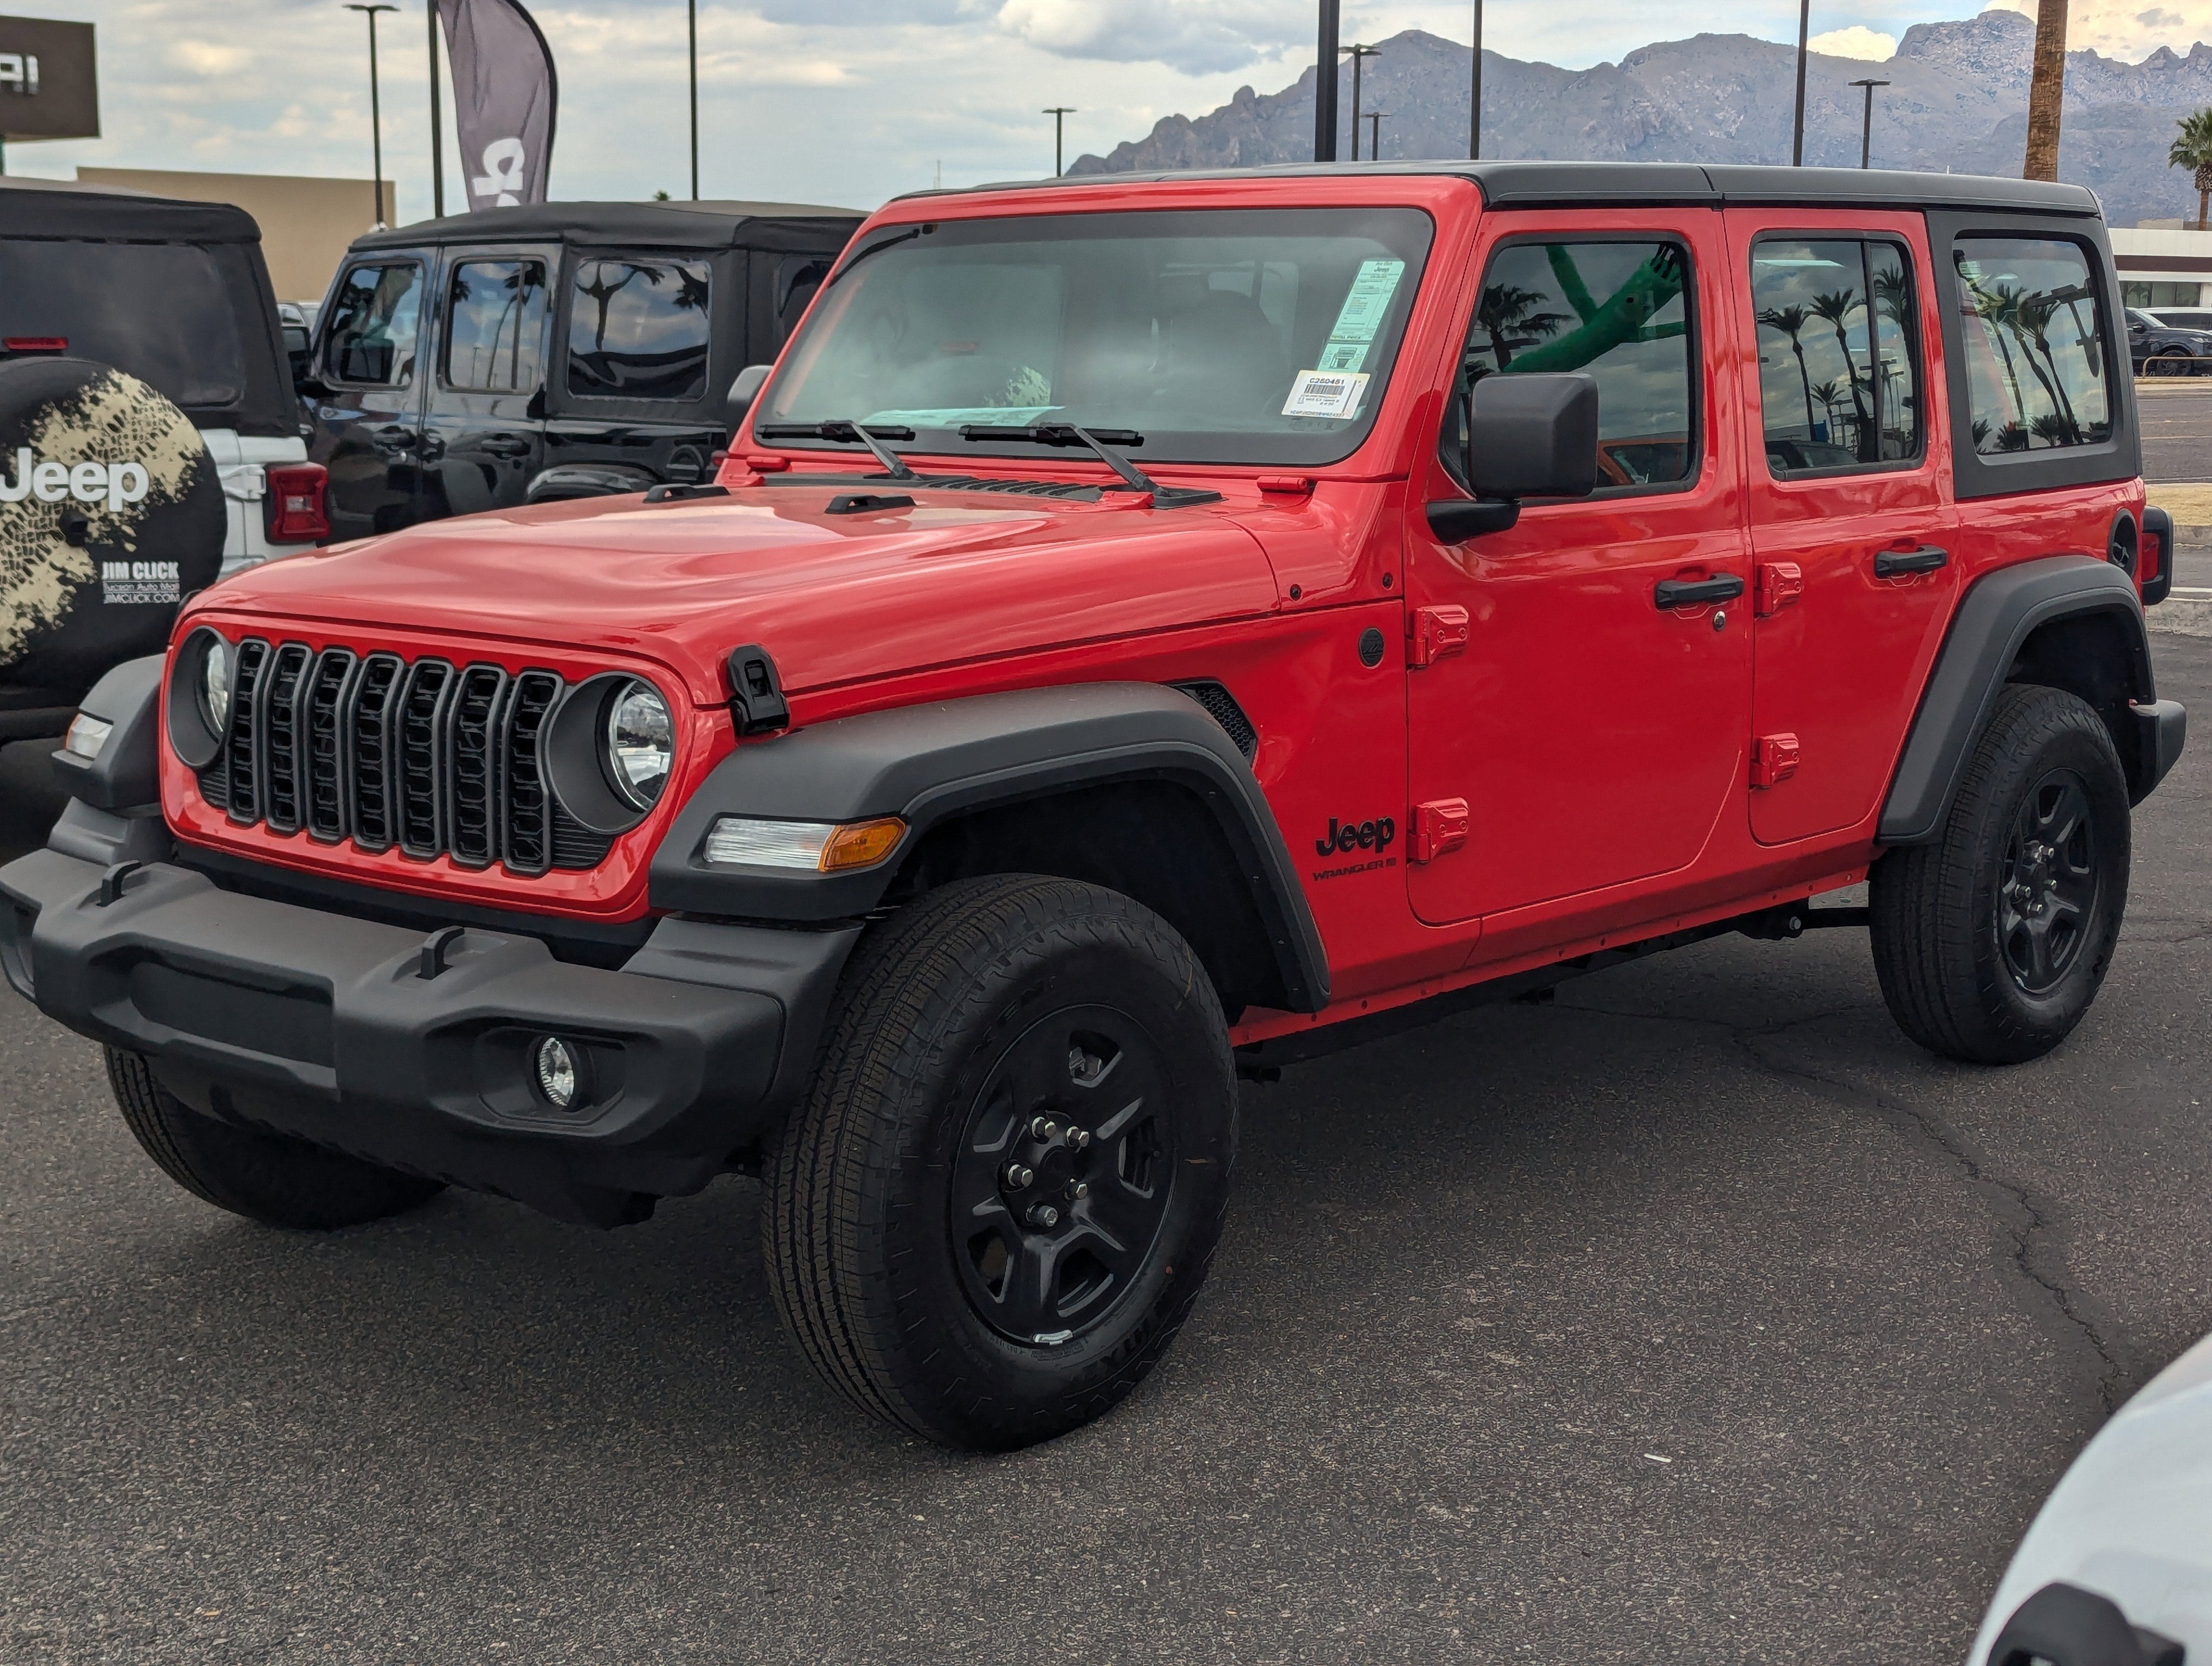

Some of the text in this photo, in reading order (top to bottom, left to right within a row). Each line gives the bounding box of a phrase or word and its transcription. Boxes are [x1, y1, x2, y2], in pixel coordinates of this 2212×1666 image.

[0, 447, 149, 512] Jeep
[102, 561, 180, 580] JIM CLICK
[1315, 816, 1394, 856] Jeep
[1312, 860, 1384, 881] WRANGLER
